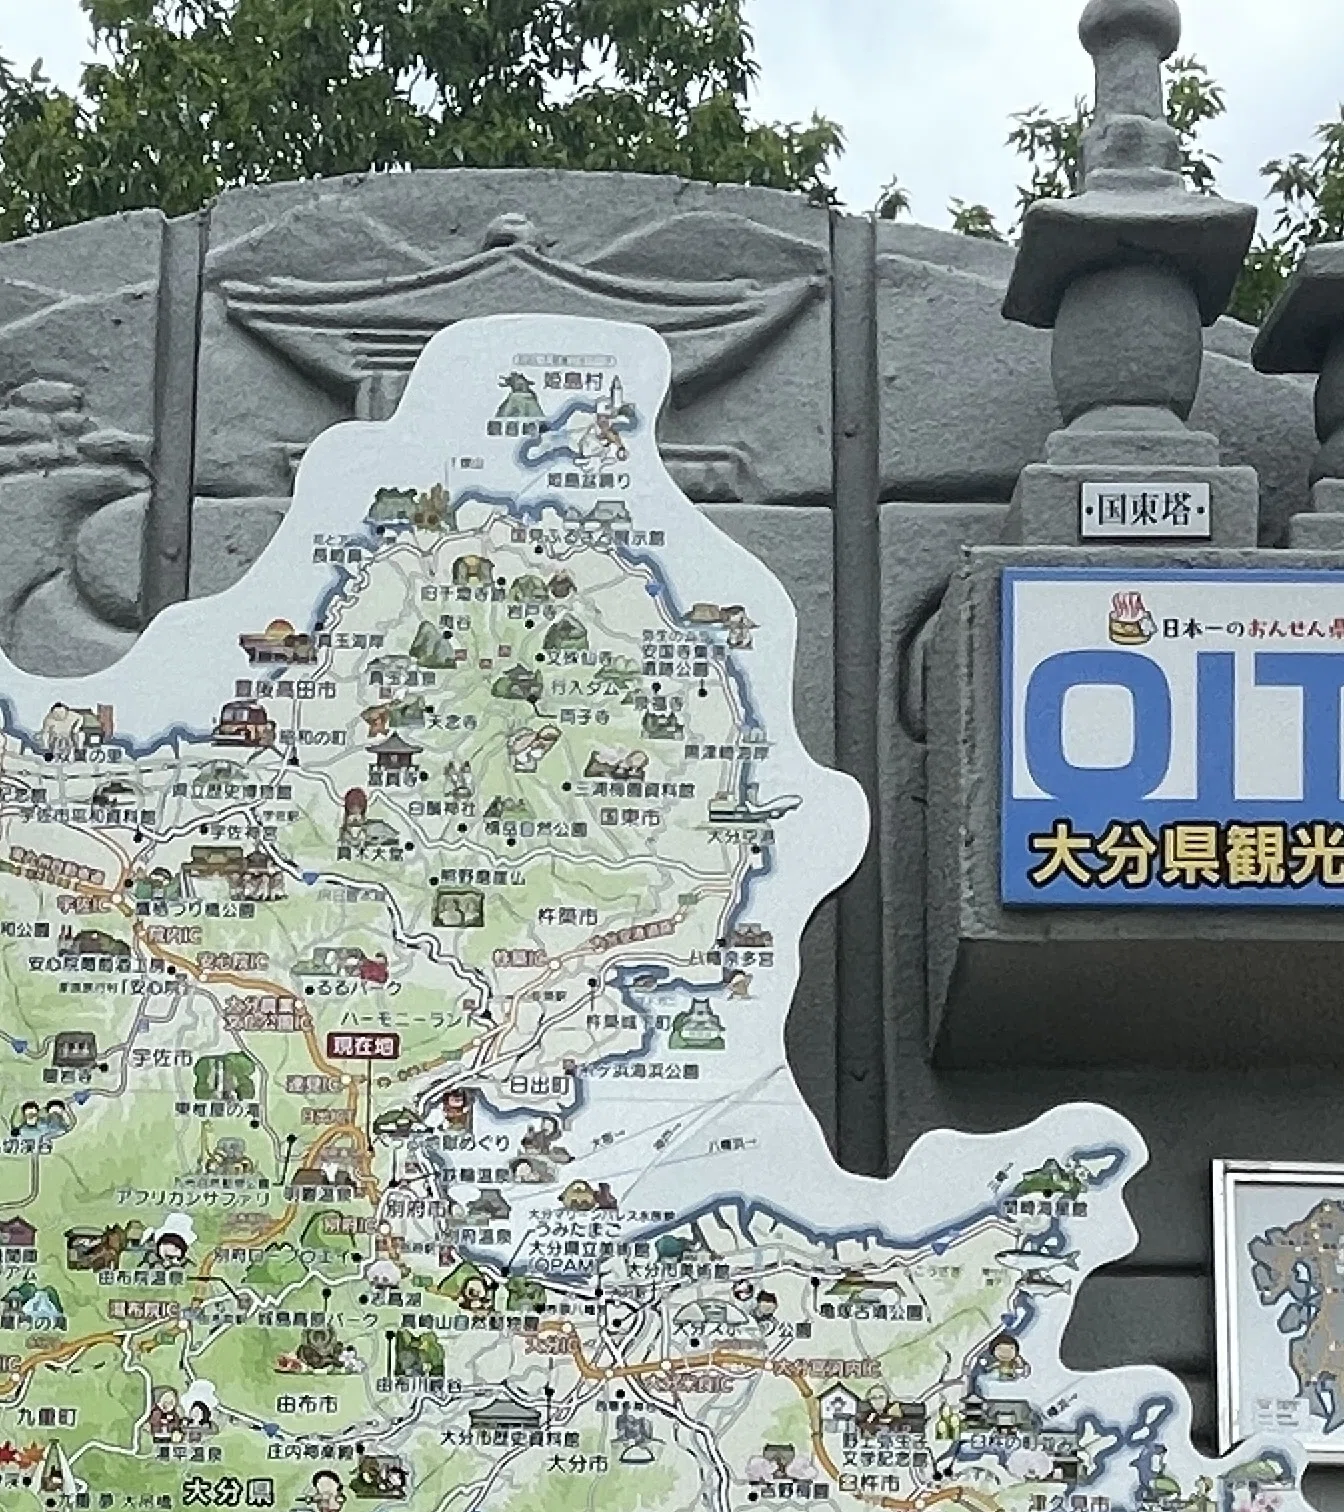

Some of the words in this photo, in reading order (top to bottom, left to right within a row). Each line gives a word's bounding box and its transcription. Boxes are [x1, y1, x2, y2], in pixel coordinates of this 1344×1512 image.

[1097, 491, 1193, 527] 国東塔
[333, 1037, 393, 1056] 現在地
[134, 1049, 192, 1067] 宇佐市
[511, 1077, 570, 1096] 日出町
[276, 1395, 338, 1413] 由布市
[547, 1456, 608, 1472] 大分市
[839, 1473, 899, 1491] 臼杵市
[183, 1476, 275, 1507] 大分県
